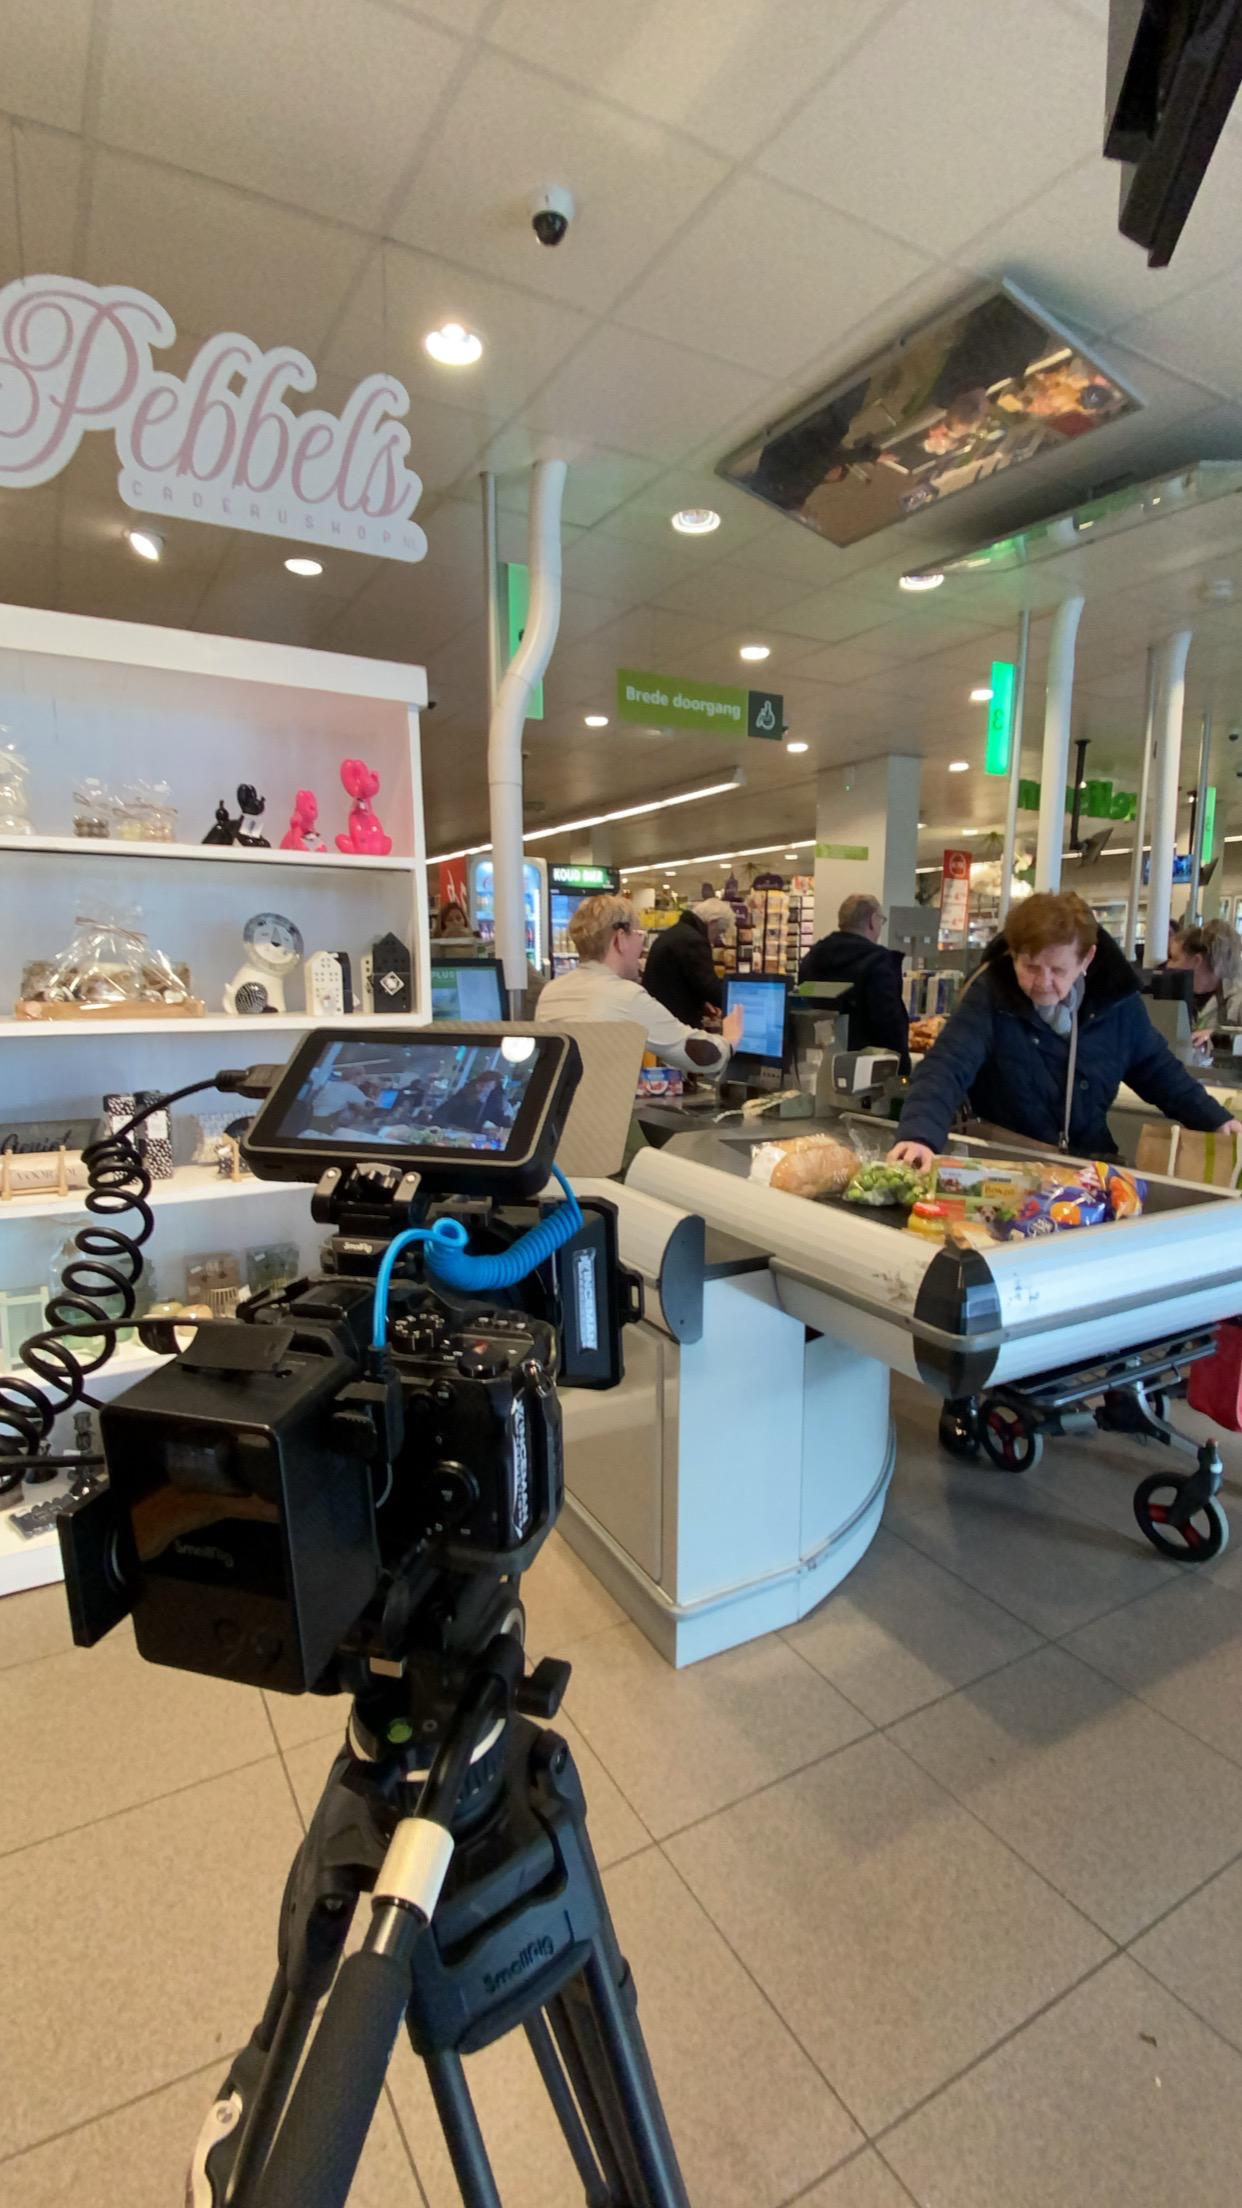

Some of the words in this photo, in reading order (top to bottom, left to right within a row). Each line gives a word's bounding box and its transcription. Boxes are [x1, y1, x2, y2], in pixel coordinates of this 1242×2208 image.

[0, 290, 411, 518] Pebbels
[131, 480, 391, 544] CADEAUSHOP
[626, 686, 669, 706] Brede
[673, 693, 741, 721] doorgang
[553, 868, 580, 882] KOUD
[482, 1935, 555, 1994] SmallRig
